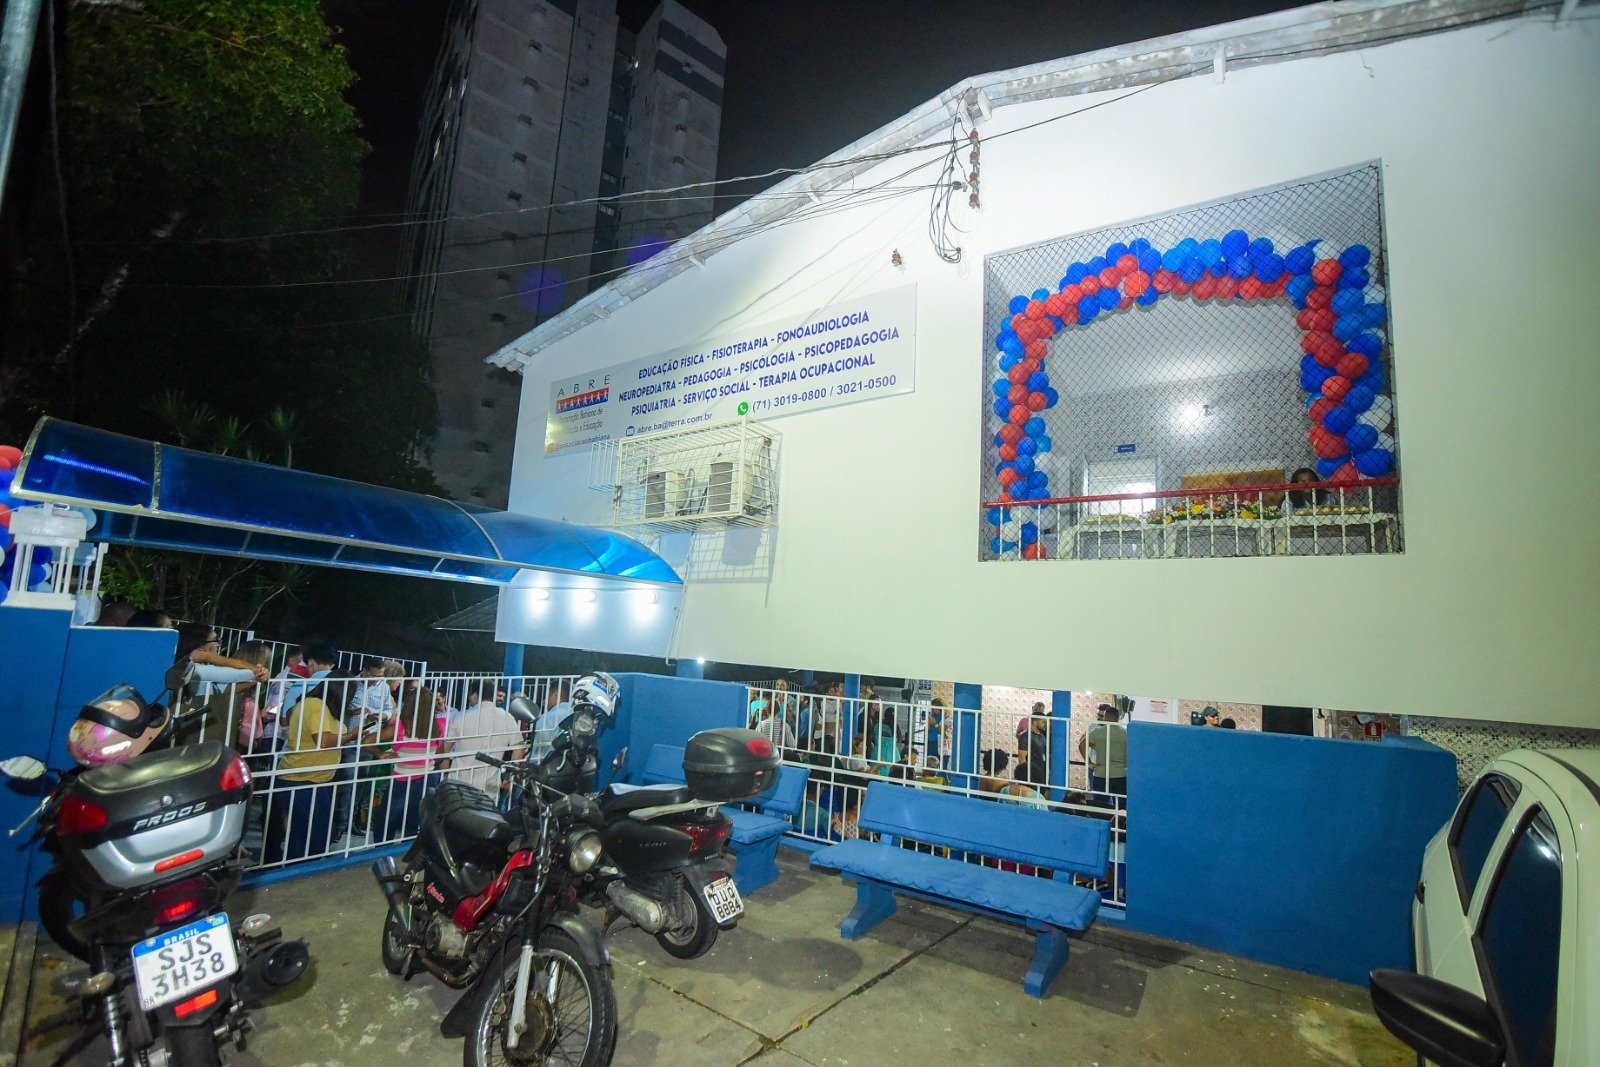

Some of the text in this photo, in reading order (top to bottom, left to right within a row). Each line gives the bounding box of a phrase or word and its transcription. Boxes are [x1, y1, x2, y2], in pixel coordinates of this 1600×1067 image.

[618, 380, 676, 402] NEUROPEDIATRA
[683, 366, 732, 387] PEDAGOGIA
[804, 326, 900, 358] PSICOPEDAGOGIA
[638, 359, 679, 380] EDUCAÇÃO
[680, 354, 705, 369] FÍSICA
[712, 337, 769, 360] FISIOTERAPIA
[776, 310, 870, 343] FONOAUDIOLOGIA
[631, 396, 676, 416] PSIQUIATRIA
[683, 387, 718, 405] SERVIÇO
[719, 380, 750, 397] SOCIAL
[759, 370, 797, 388] TERAPIA
[799, 353, 876, 379] OCUPACIONAL
[752, 399, 771, 413] (71)
[774, 387, 827, 407] 3019-0800
[836, 374, 897, 395] 3021-0500
[636, 412, 713, 434] abre.ba@terra.com.br
[716, 896, 741, 918] 8884
[158, 933, 213, 971] SJS
[164, 928, 200, 946] BRASIL
[151, 952, 225, 998] 3H38
